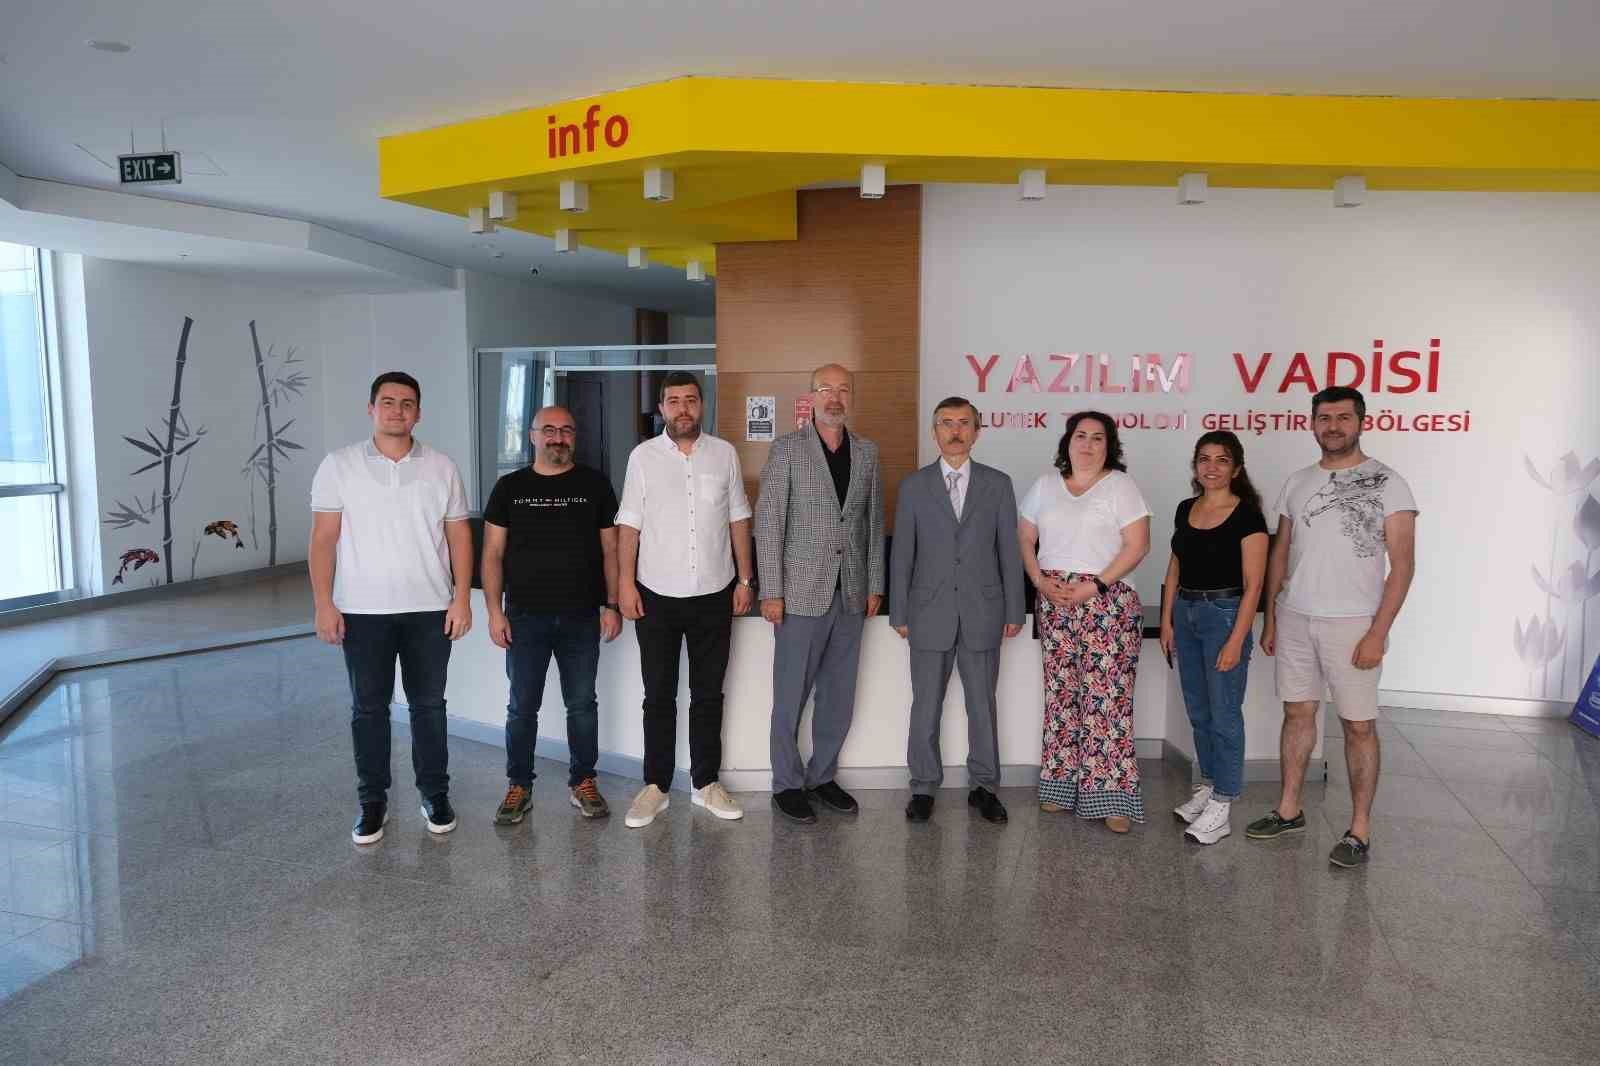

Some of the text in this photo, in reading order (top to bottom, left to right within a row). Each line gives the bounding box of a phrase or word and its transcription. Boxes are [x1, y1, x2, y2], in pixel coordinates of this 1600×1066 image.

[548, 105, 629, 158] info
[124, 159, 155, 180] EXIT
[965, 338, 1441, 393] YAZILIM VADİSİ
[978, 412, 1047, 429] LUTEK
[1202, 409, 1315, 435] GELİŞTİR
[1362, 409, 1470, 432] BÖLGESİ
